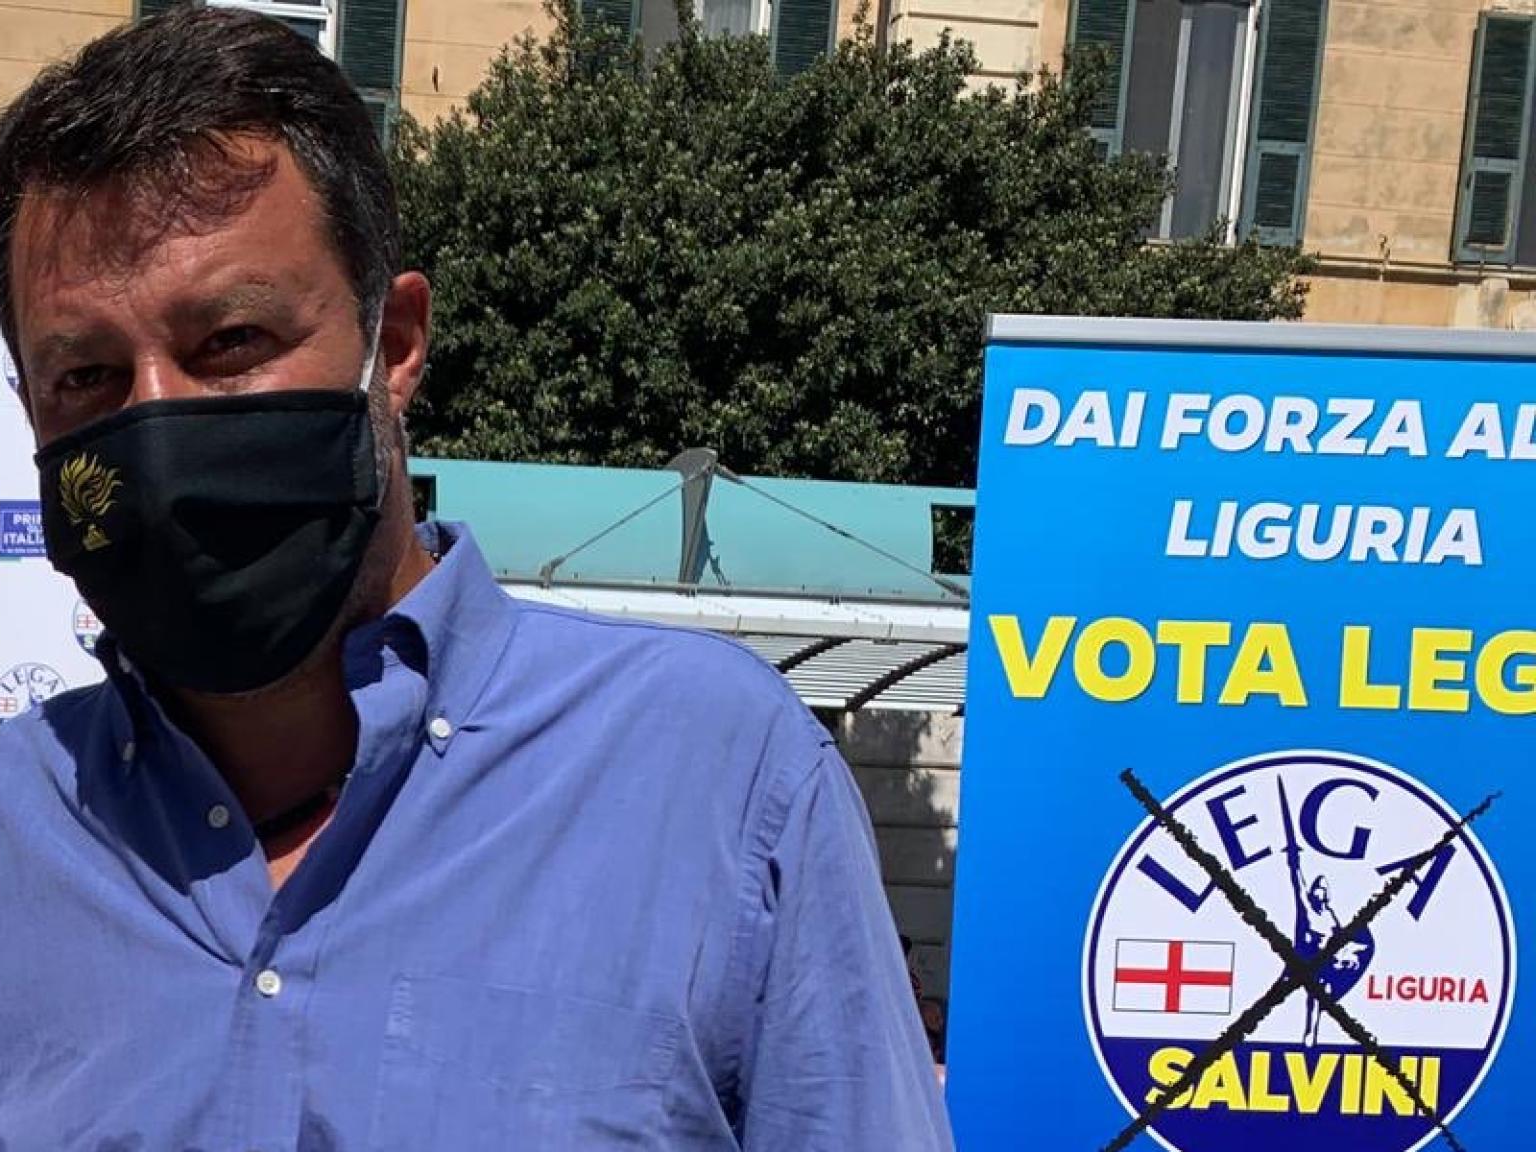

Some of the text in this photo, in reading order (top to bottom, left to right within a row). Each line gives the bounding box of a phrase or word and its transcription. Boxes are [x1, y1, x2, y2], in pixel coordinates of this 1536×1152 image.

[1003, 386, 1148, 449] DAI
[1160, 392, 1429, 457] FORZA
[12, 513, 41, 525] PRI
[1165, 498, 1484, 567] LIGURIA
[987, 613, 1536, 716] VOTA LEG
[1135, 776, 1457, 922] LEGA
[1367, 974, 1489, 1004] LIGURIA
[1144, 1045, 1441, 1119] SALVINI
